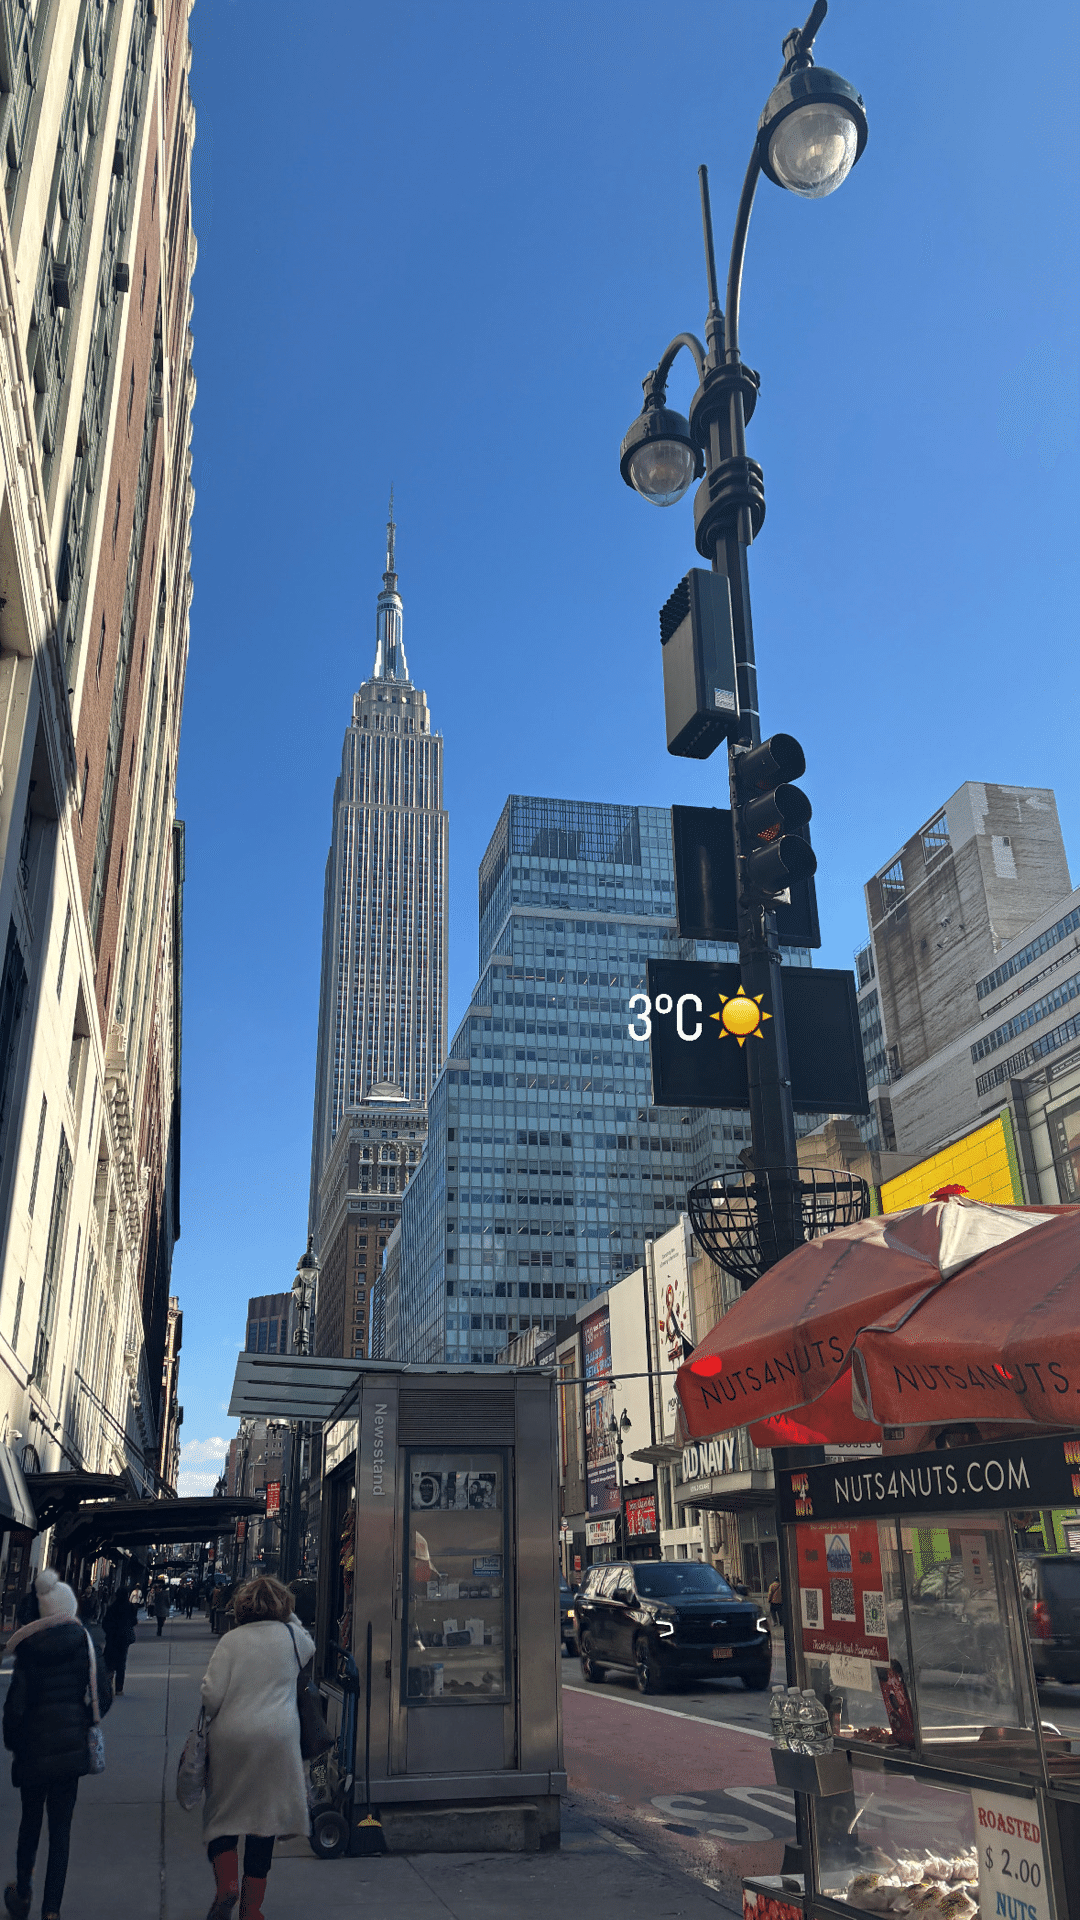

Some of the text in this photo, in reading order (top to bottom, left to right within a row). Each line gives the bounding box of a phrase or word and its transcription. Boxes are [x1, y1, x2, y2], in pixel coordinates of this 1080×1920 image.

[700, 1335, 845, 1410] NUTS4NUTS
[372, 1403, 388, 1497] Newsstand
[682, 1436, 735, 1484] OLD NAVY
[833, 1456, 1031, 1504] NUTS4NUTS.COM
[977, 1806, 1041, 1844] ROASTED
[985, 1845, 1041, 1888] $ 2.00
[996, 1890, 1038, 1920] NUTS
